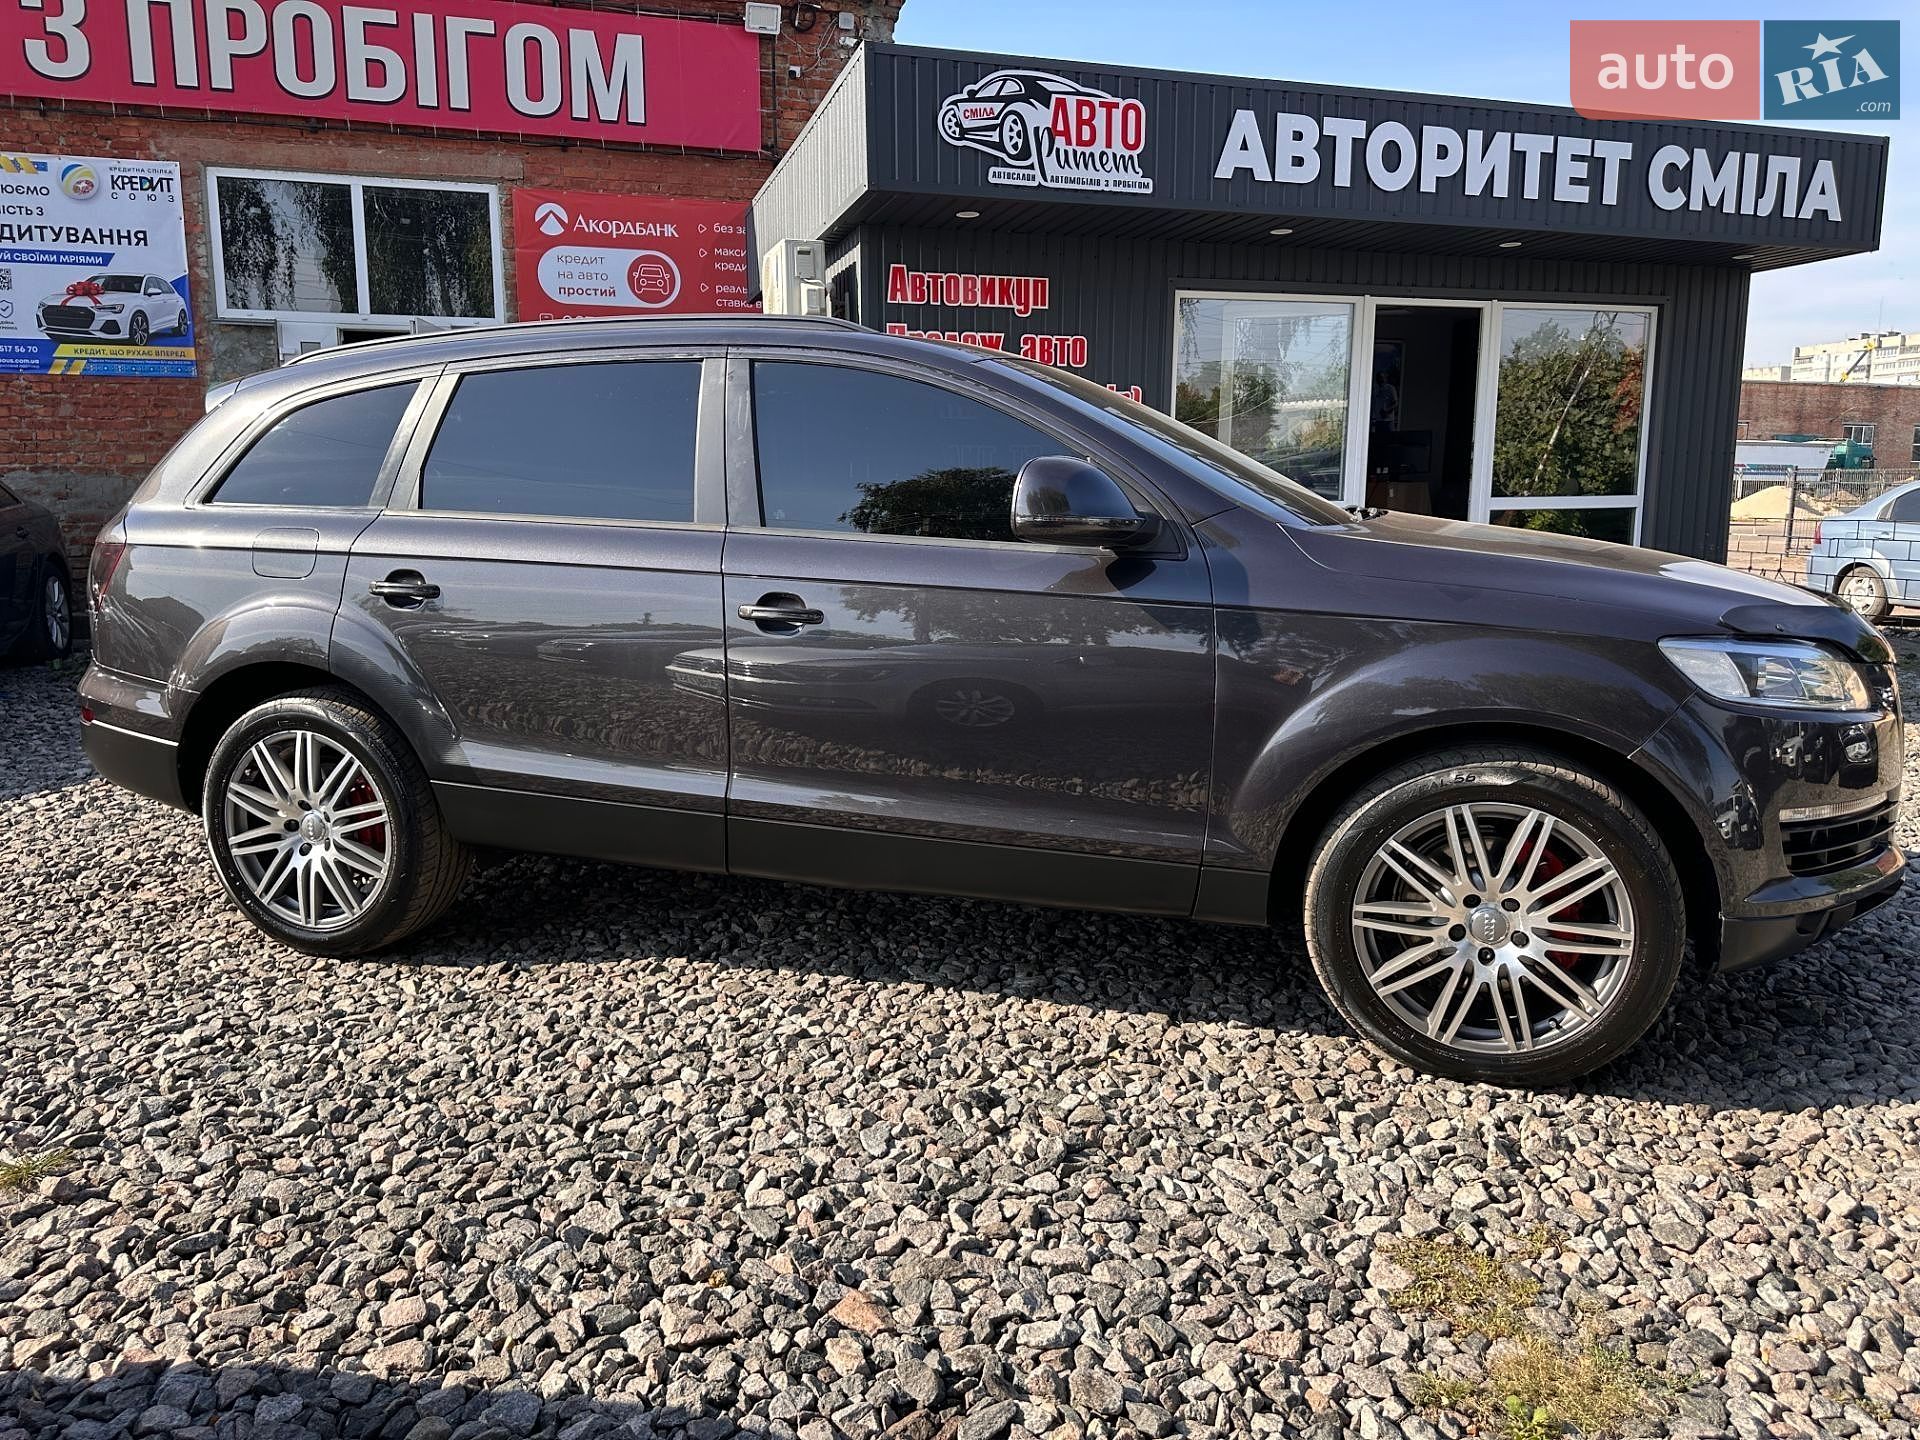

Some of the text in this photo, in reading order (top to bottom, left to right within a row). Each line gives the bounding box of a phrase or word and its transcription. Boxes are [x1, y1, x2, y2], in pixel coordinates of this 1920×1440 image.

[24, 0, 647, 125] З ПРОБІГОМ
[963, 107, 995, 119] СМІЛА
[1051, 97, 1142, 151] АВТО
[109, 166, 146, 174] КРЕДИТНА
[1213, 109, 1841, 222] АВТОРИТЕТ СМІЛА
[111, 175, 174, 193] КРЕДИТ
[992, 171, 1036, 182] АВТОСАЛОН
[1050, 175, 1101, 187] АВТОМОБІЛІВ
[1112, 179, 1150, 190] ПРОБІГОМ
[0, 205, 33, 216] ІСТЬ
[713, 222, 733, 234] без
[13, 252, 57, 262] СВОЇМИ
[60, 254, 103, 264] МРІЯМИ
[557, 254, 606, 265] кредит
[557, 270, 609, 281] на авто
[558, 286, 616, 298] простий
[887, 263, 1049, 317] Автовикуп
[27, 345, 38, 353] 70
[155, 349, 186, 358] ВПЕРЕД
[1020, 334, 1088, 368] авто
